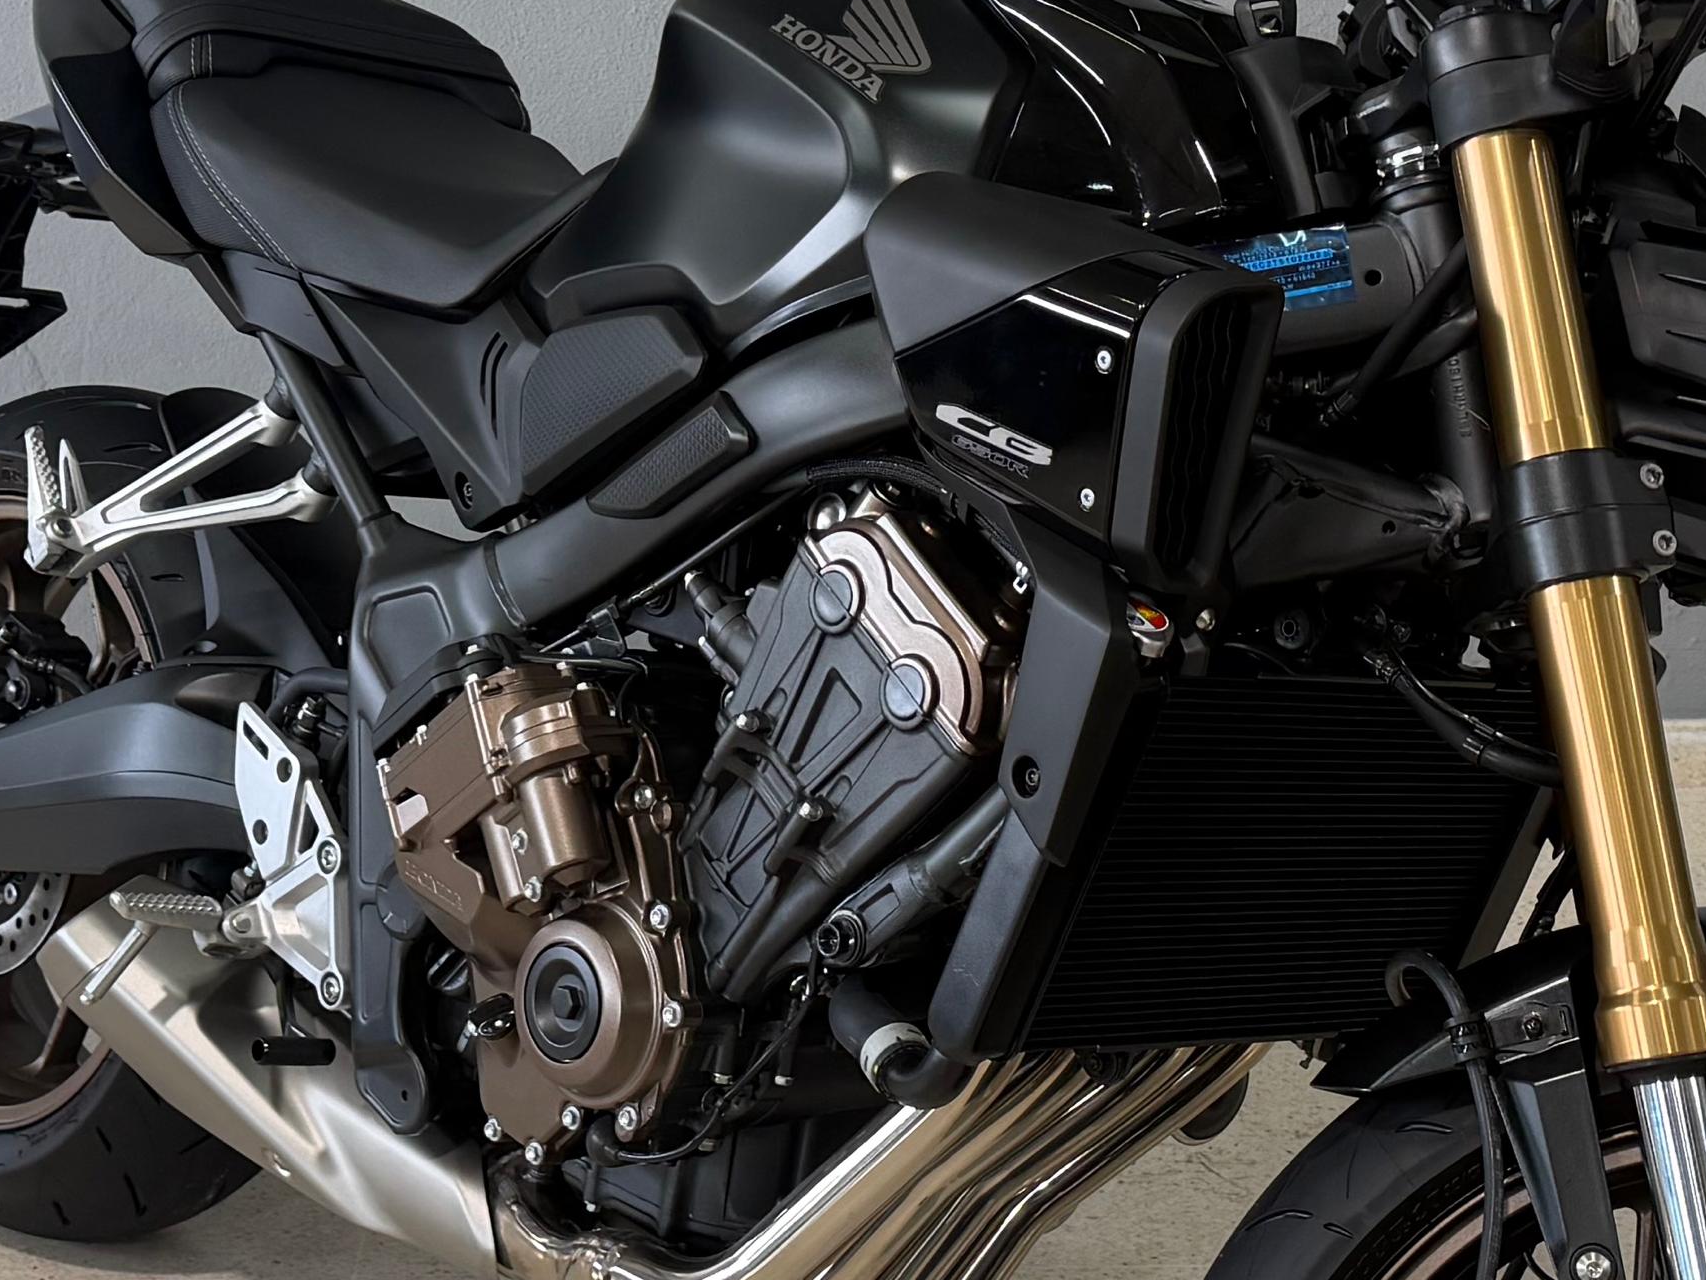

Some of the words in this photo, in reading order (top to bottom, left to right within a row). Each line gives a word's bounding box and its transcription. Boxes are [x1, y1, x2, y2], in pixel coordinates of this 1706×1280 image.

[770, 13, 885, 102] HONDA
[935, 404, 1054, 466] CB
[952, 434, 1030, 479] 650R
